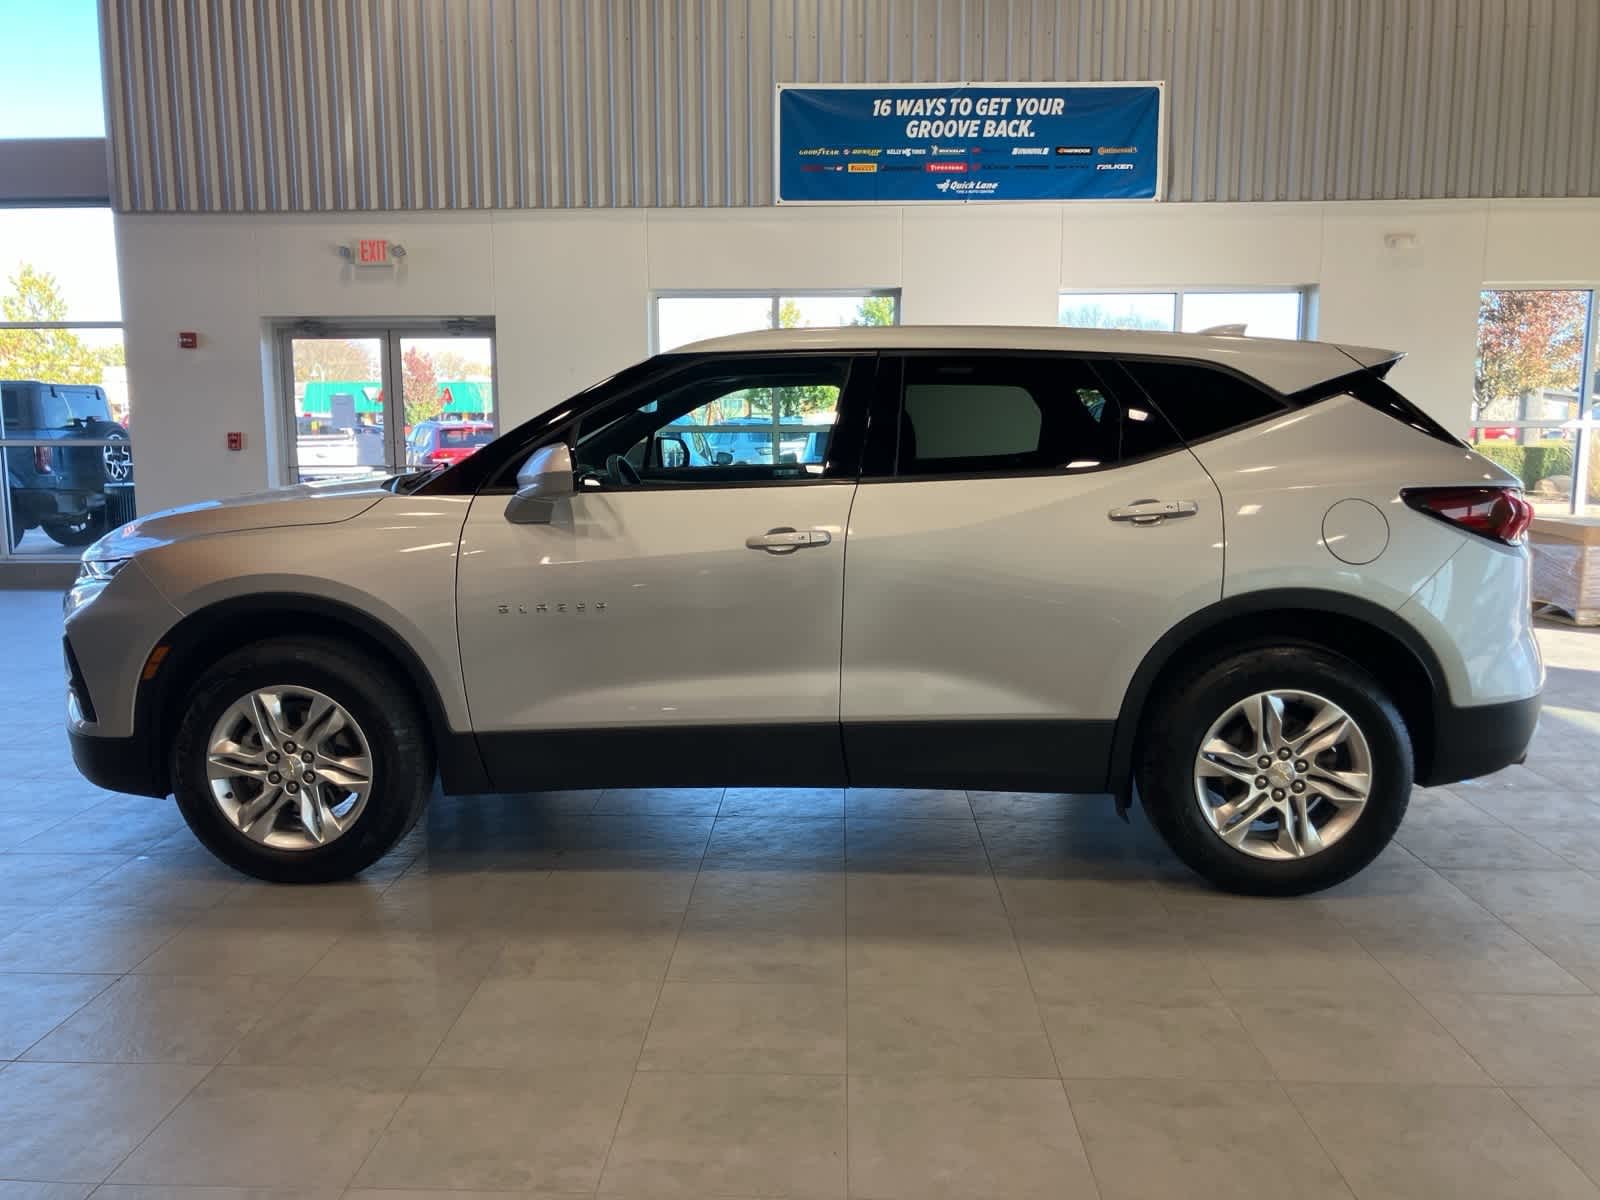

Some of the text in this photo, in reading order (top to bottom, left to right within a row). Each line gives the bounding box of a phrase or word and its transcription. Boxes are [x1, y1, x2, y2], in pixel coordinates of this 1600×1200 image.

[873, 98, 1065, 117] 16 WAYS TO GET YOUR
[906, 119, 1036, 138] GROOVE BACK.
[798, 147, 840, 157] GOODYEAR
[949, 181, 999, 190] Quick Lane
[359, 240, 387, 262] EXIT
